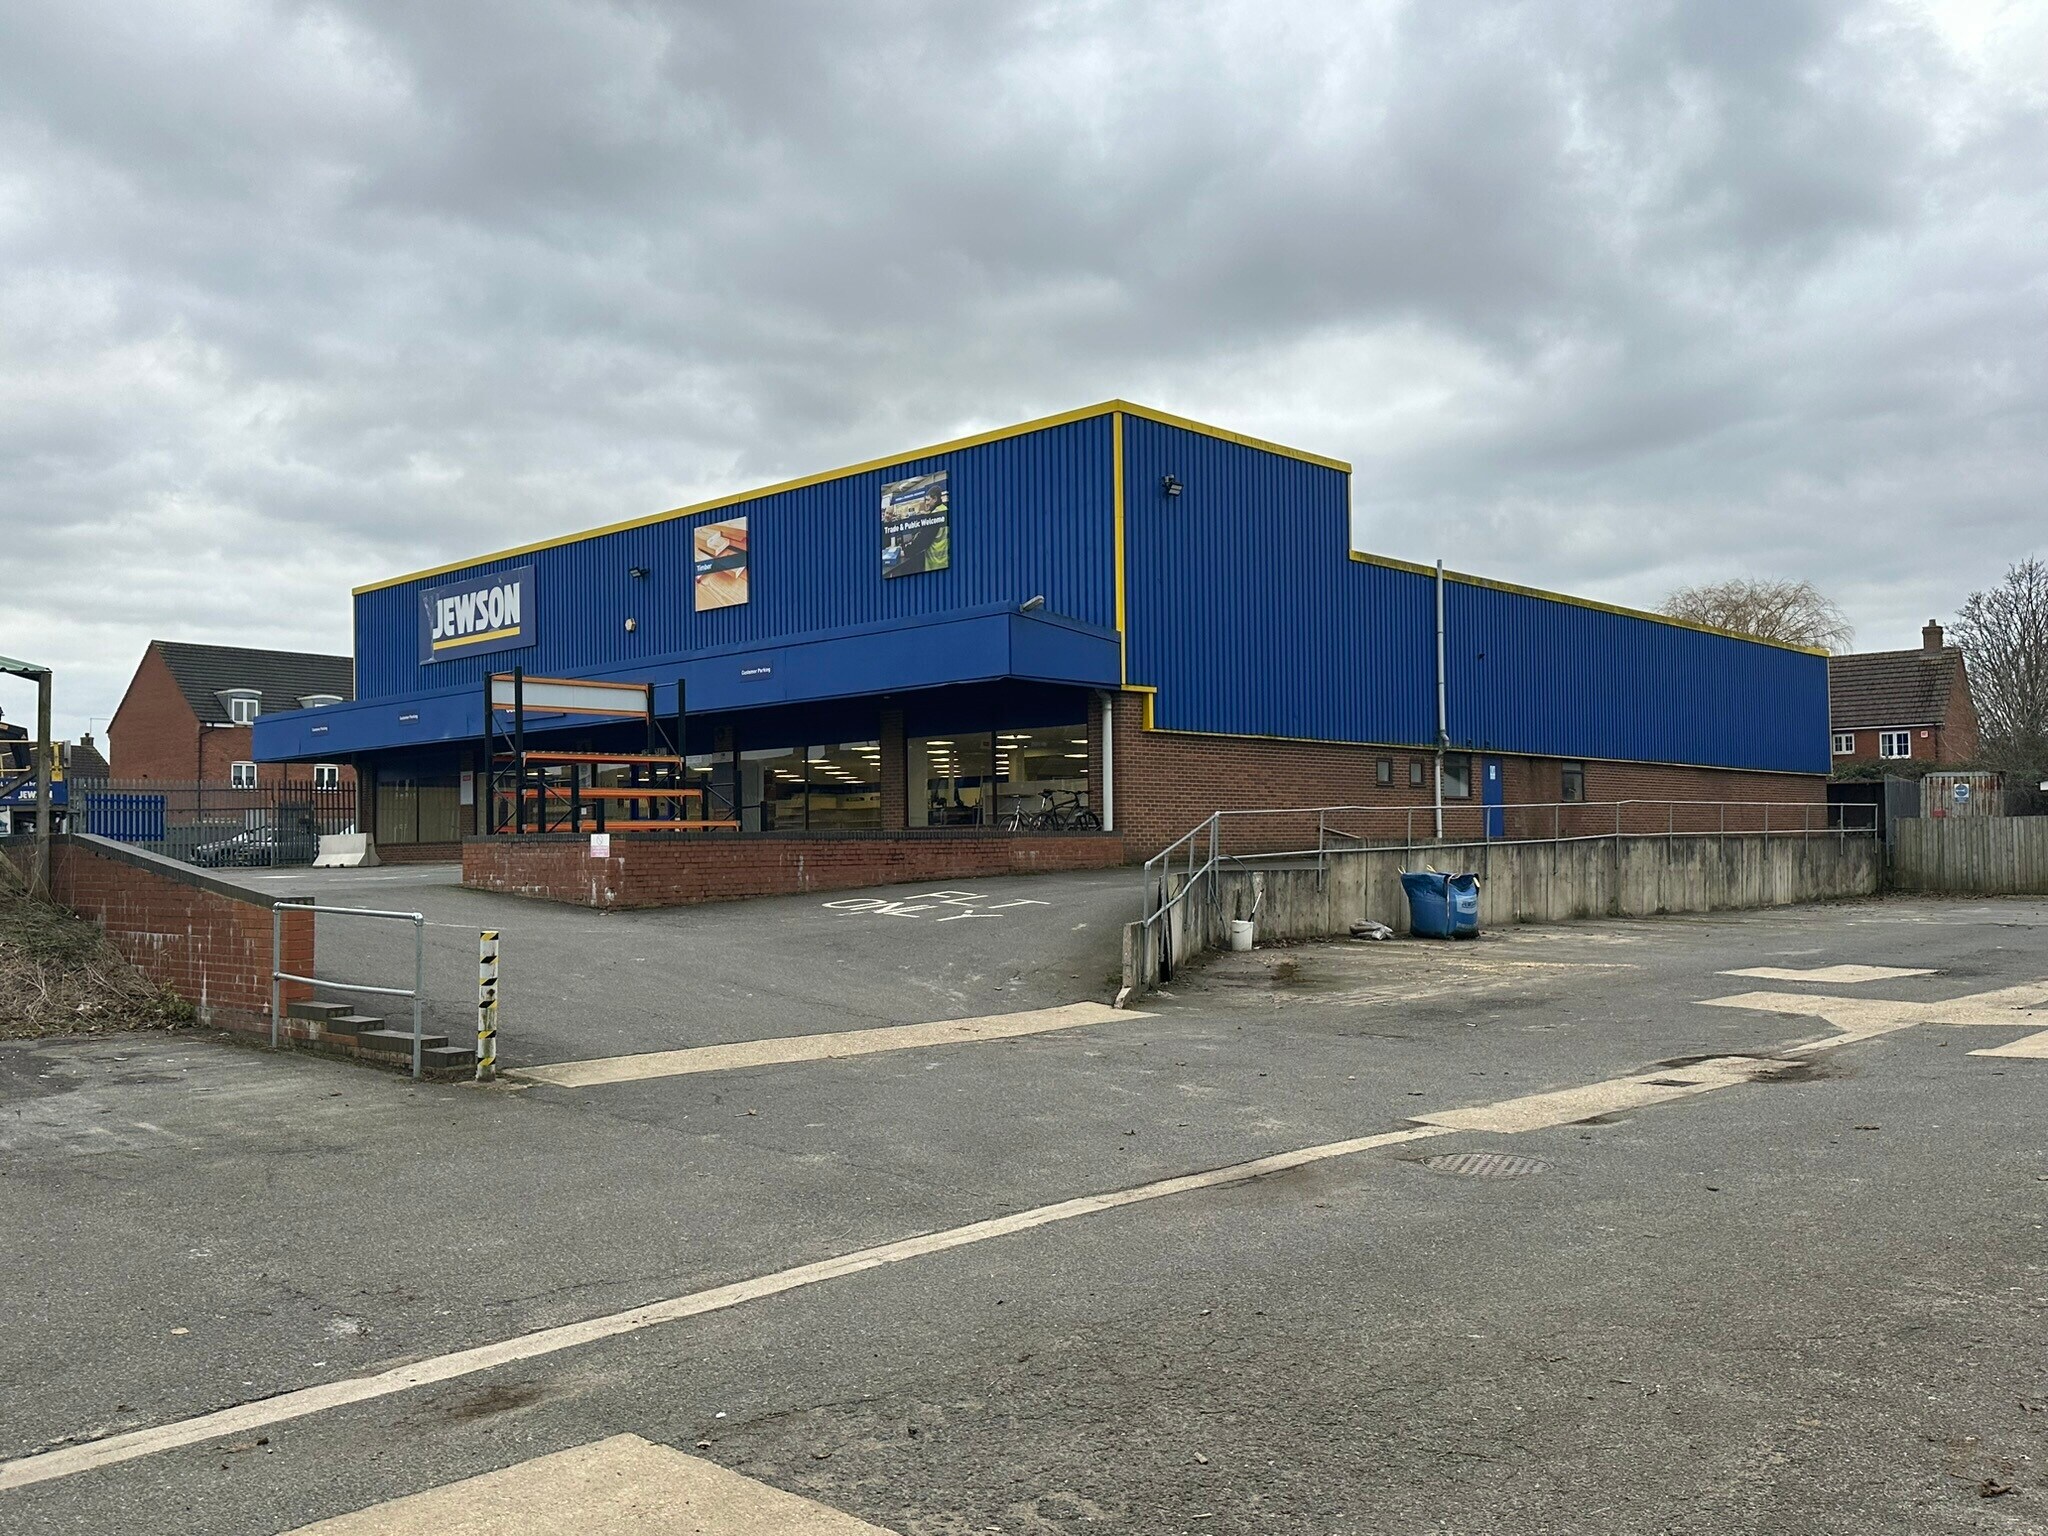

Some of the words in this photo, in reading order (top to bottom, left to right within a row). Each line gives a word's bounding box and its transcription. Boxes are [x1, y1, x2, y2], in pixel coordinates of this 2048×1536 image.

[884, 525, 899, 534] Trade
[900, 523, 904, 531] &
[904, 521, 920, 530] Public
[920, 516, 945, 526] Welcome
[432, 582, 520, 640] JEWSON
[822, 898, 1004, 922] ONLY
